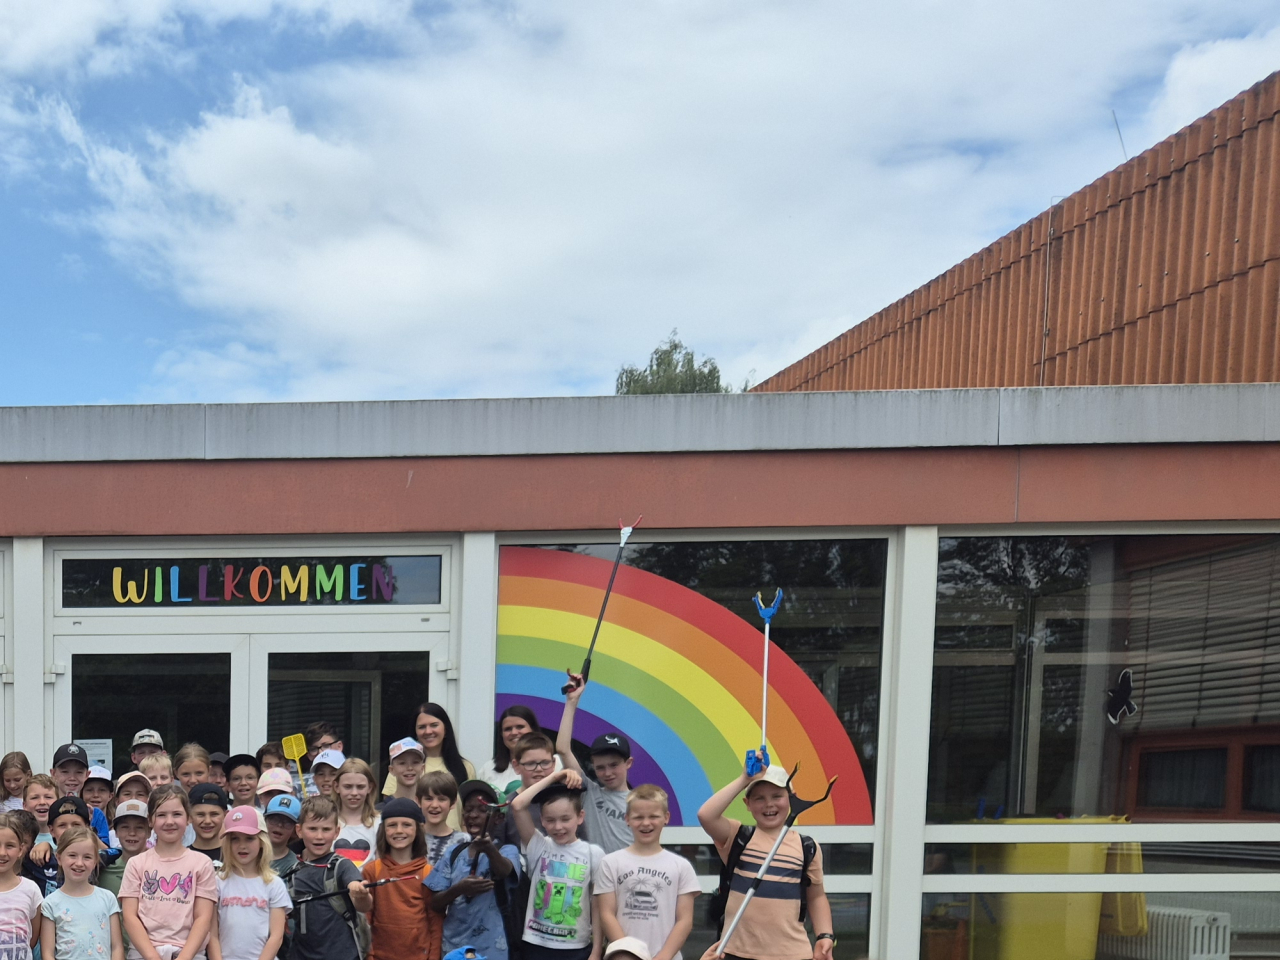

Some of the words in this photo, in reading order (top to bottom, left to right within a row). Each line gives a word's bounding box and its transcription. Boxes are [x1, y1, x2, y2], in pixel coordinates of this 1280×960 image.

[112, 563, 394, 604] WILLKOMMEN
[605, 807, 628, 821] JAK
[616, 870, 635, 886] Los
[637, 866, 673, 887] Angeles
